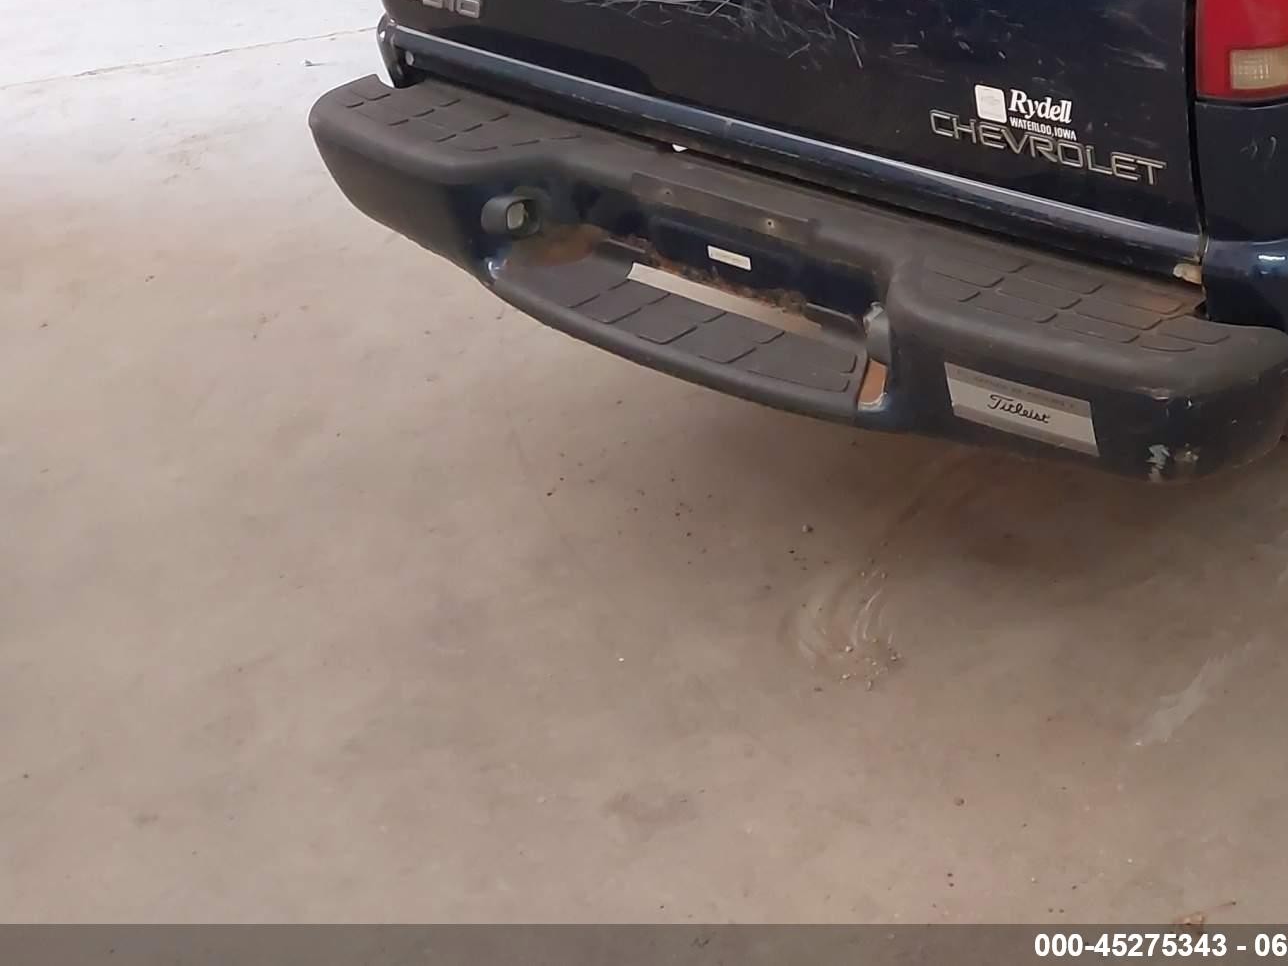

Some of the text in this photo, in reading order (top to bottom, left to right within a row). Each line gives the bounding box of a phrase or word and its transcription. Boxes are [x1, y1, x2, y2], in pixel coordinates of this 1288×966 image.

[1009, 89, 1073, 124] Rydell
[929, 109, 1167, 185] CHEVROLET
[987, 394, 1051, 424] Titleist
